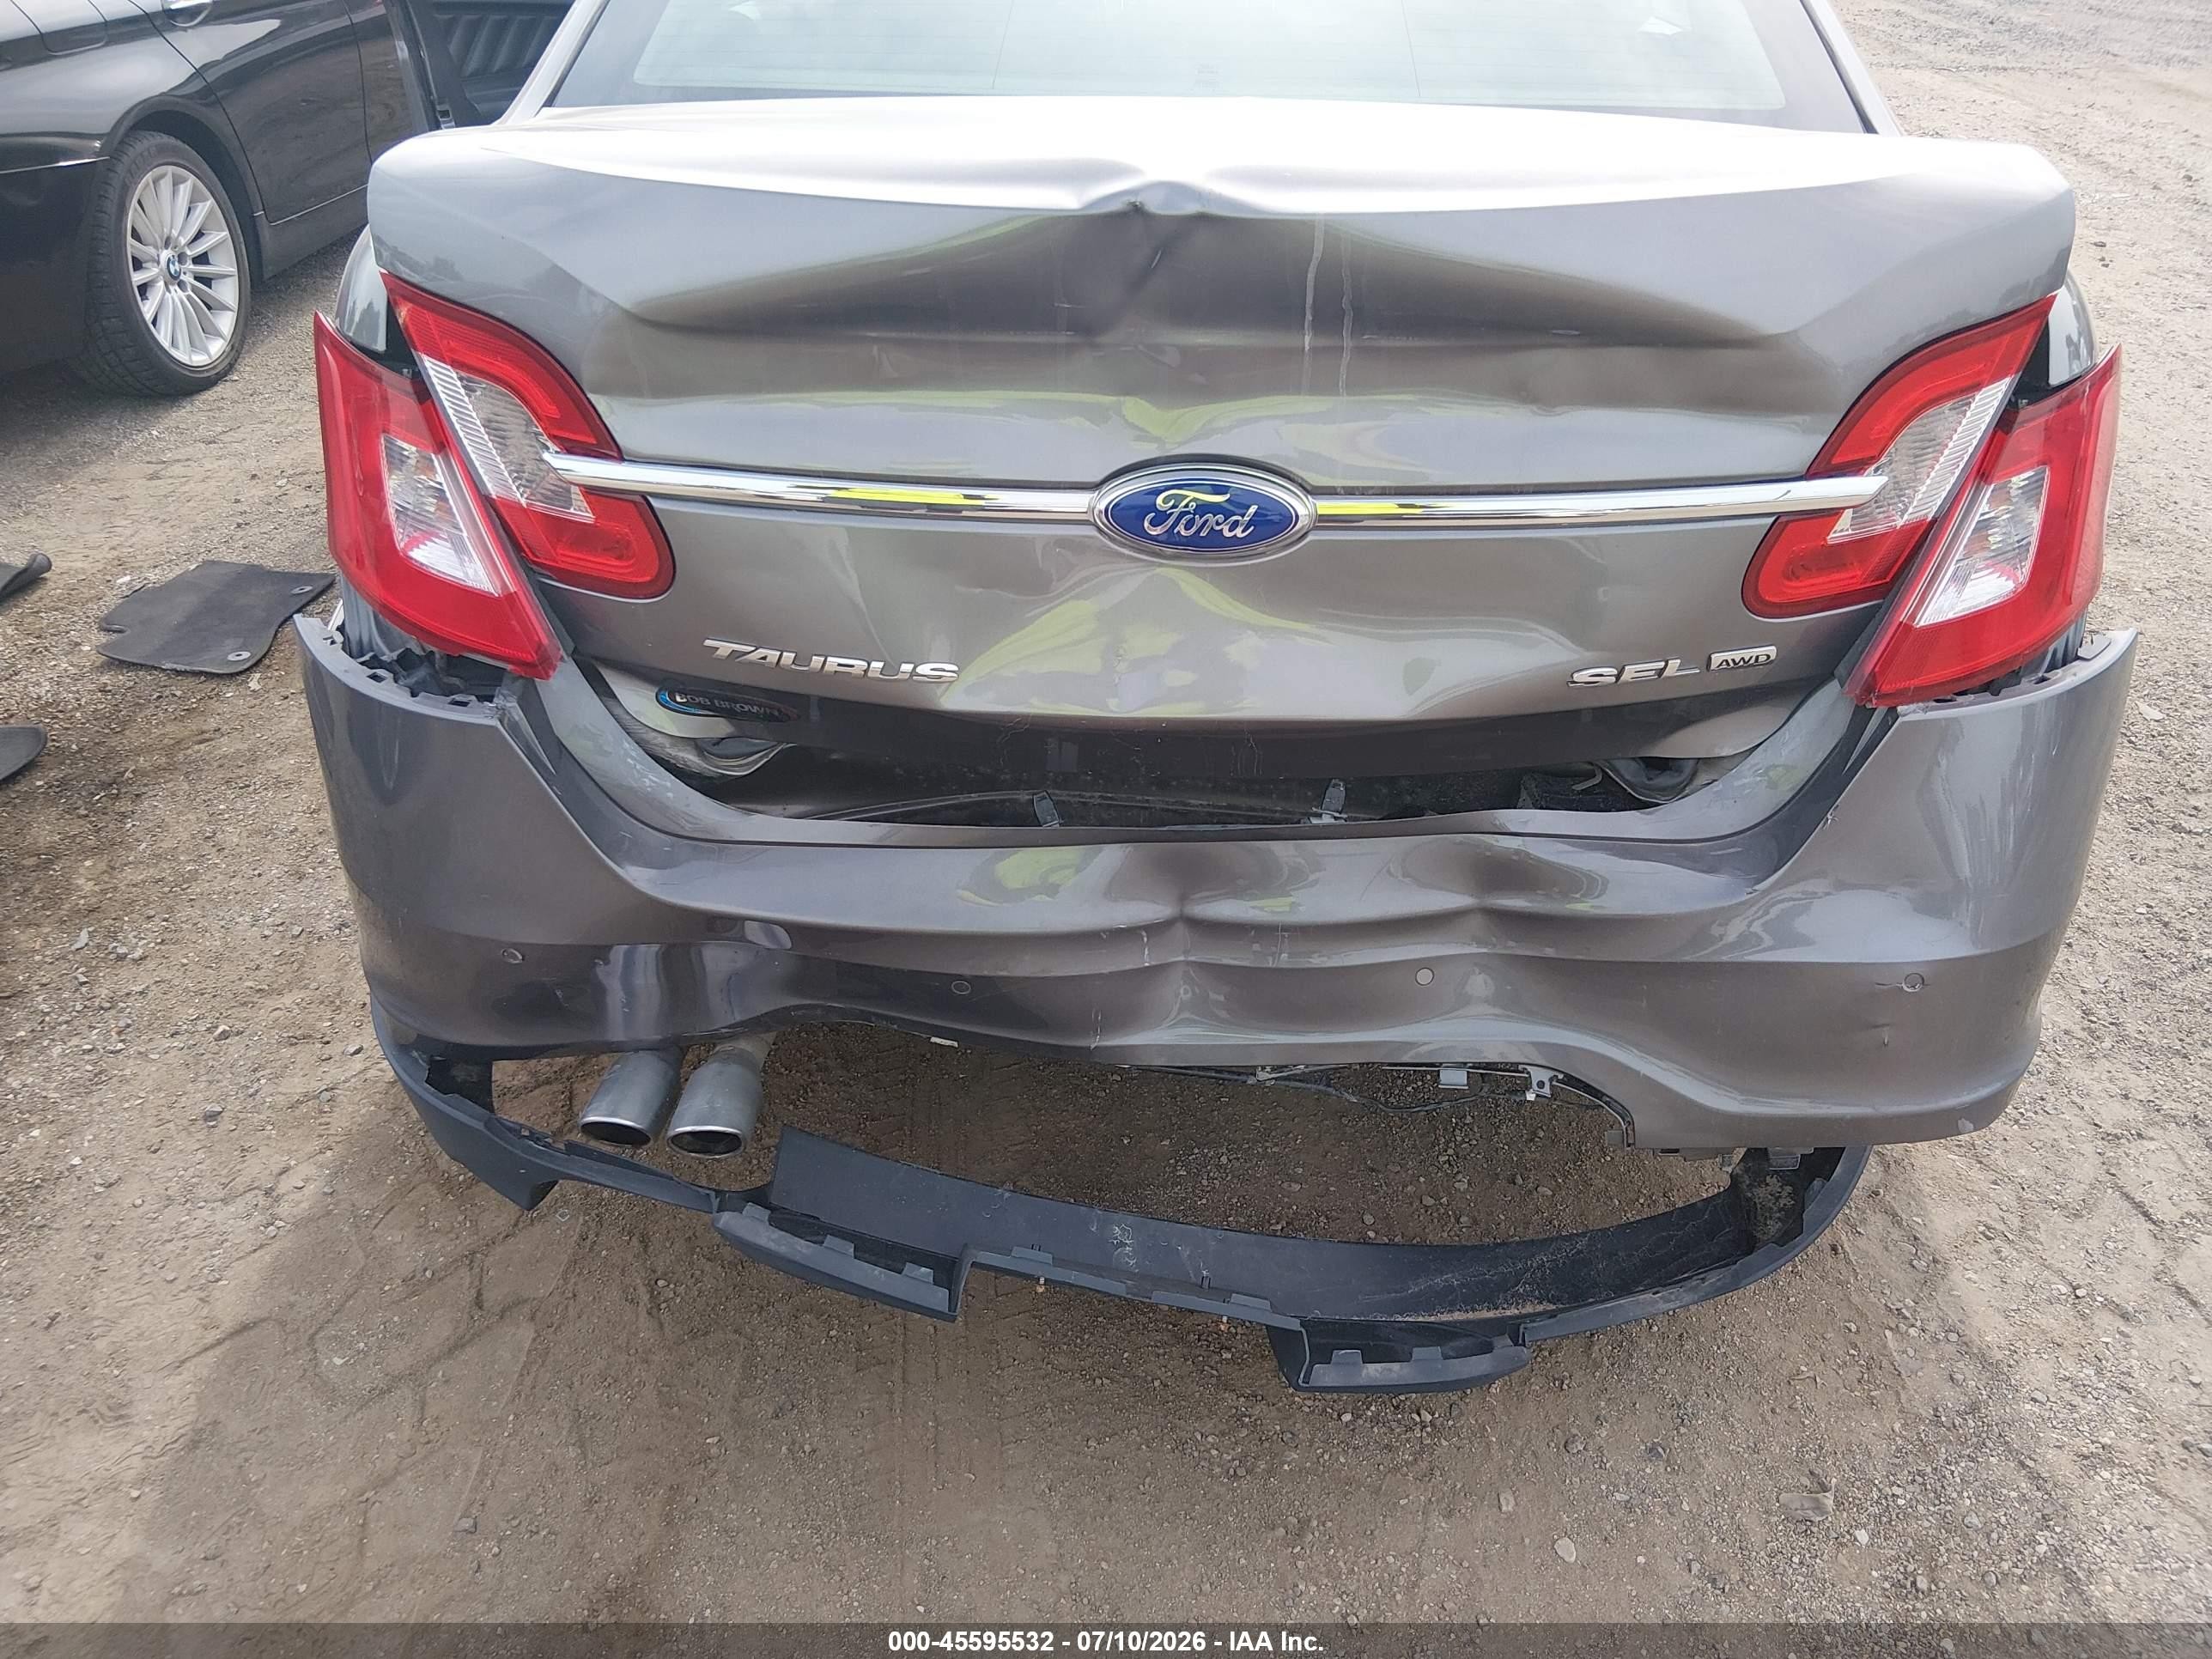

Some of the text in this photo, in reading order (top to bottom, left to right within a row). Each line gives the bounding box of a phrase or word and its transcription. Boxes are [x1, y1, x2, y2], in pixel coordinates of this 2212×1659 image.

[1143, 489, 1258, 538] Ford
[702, 638, 960, 683] TAURUS
[1566, 653, 1771, 688] SEL AWD
[674, 692, 780, 717] BOB BROWN
